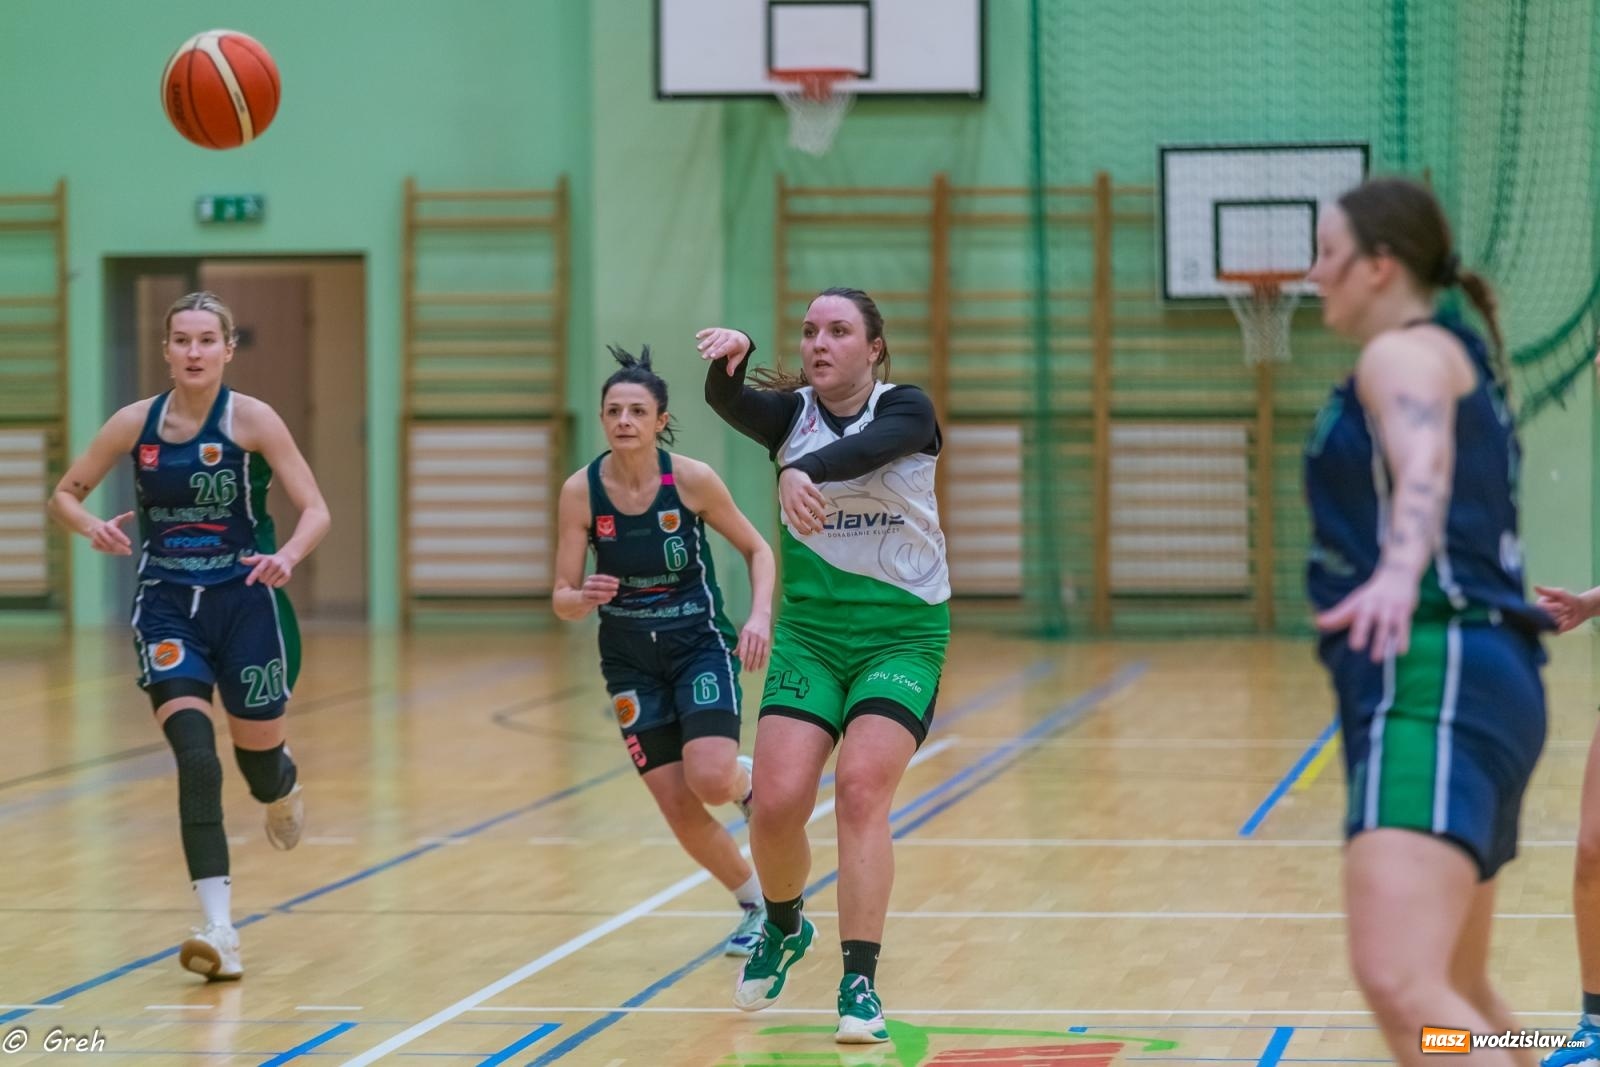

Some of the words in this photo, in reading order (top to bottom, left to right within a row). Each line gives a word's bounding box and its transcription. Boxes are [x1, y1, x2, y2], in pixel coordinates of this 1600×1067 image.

[190, 469, 237, 506] 26
[664, 536, 688, 572] 6
[240, 658, 284, 708] 26
[692, 672, 720, 705] 6
[762, 670, 810, 700] 24
